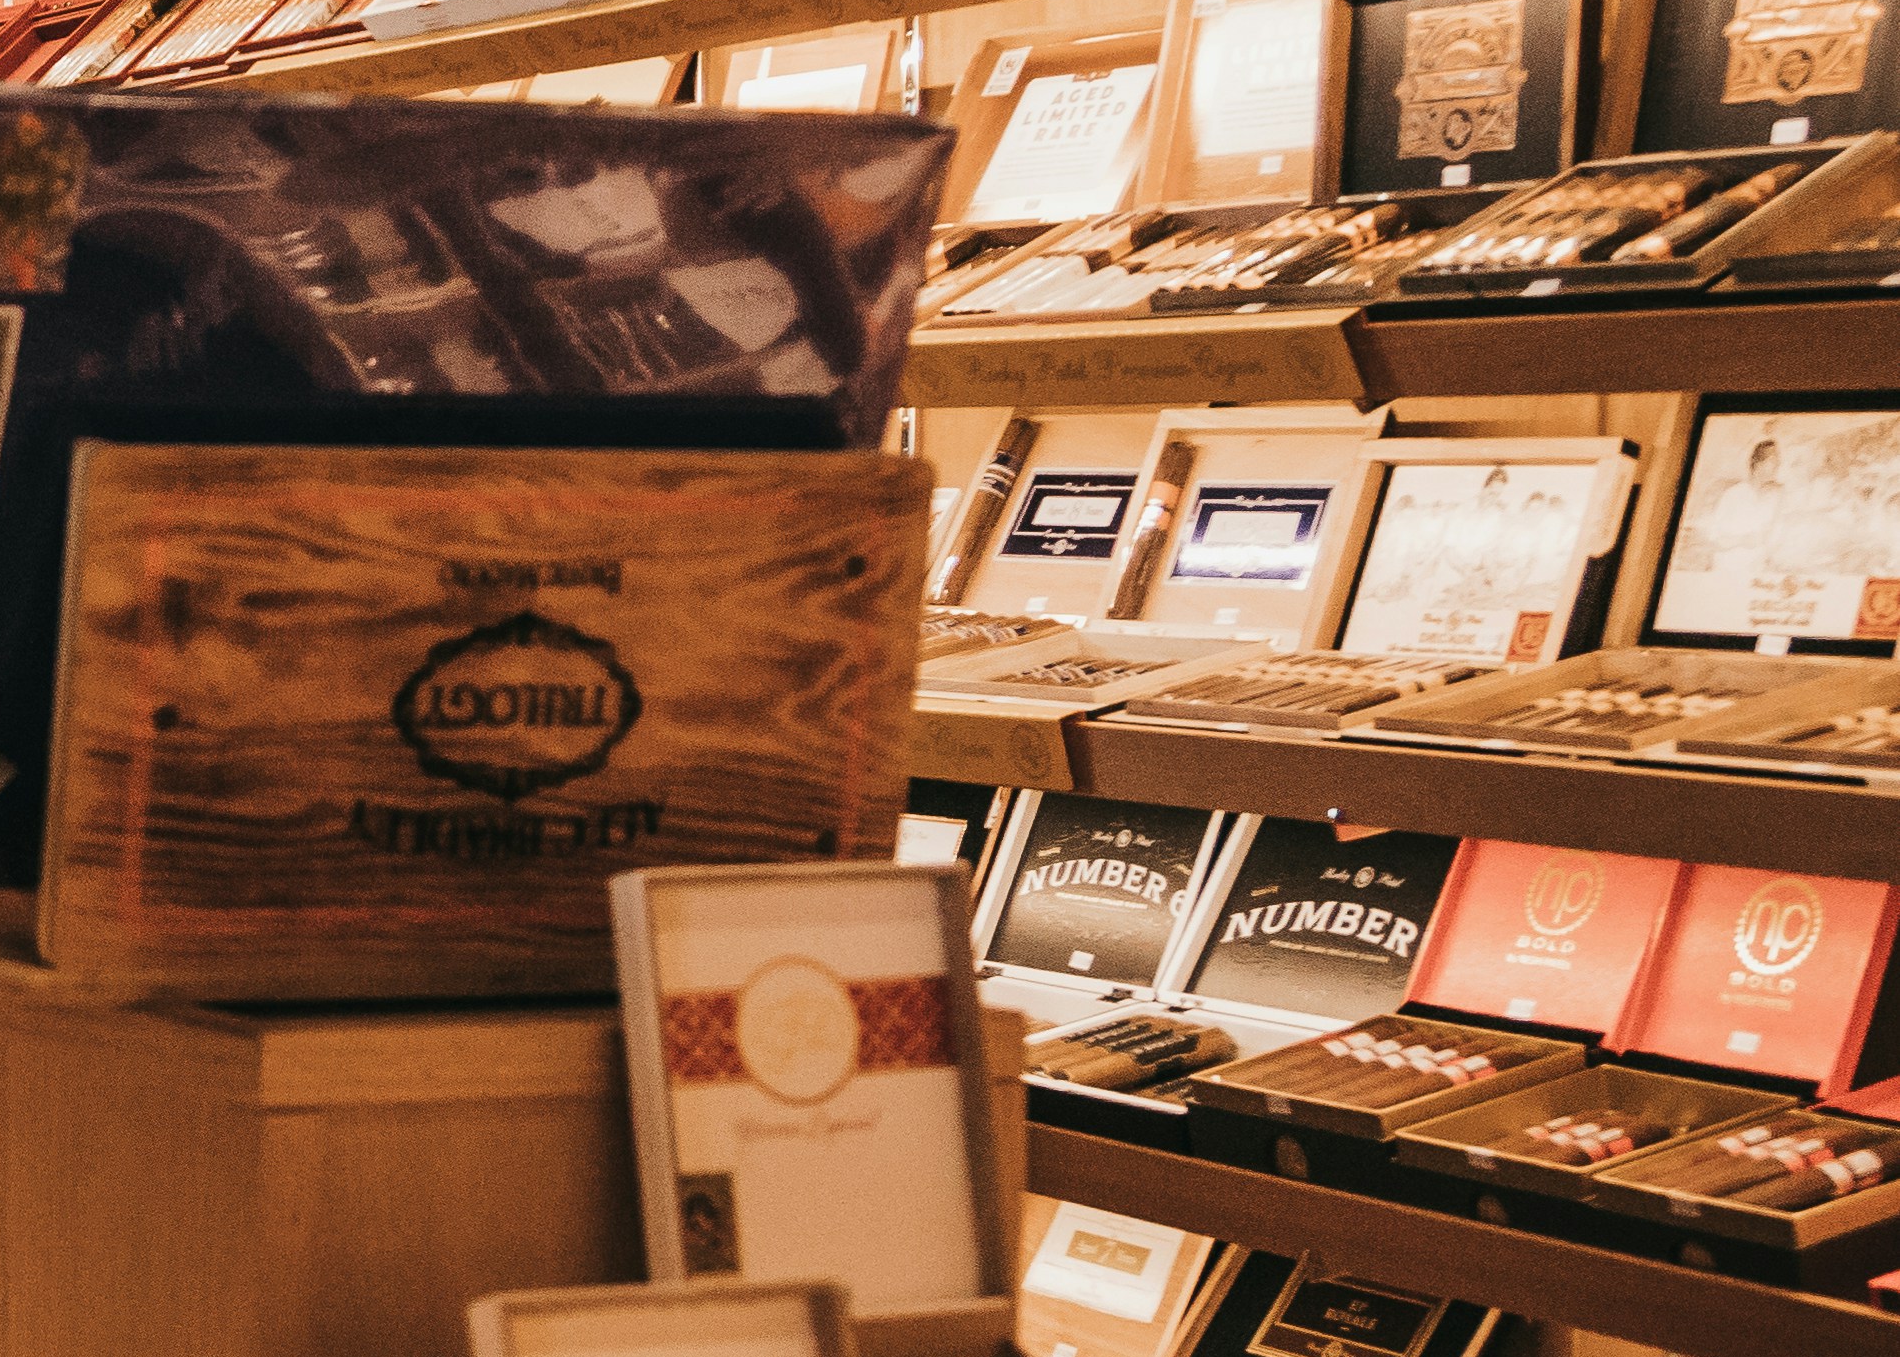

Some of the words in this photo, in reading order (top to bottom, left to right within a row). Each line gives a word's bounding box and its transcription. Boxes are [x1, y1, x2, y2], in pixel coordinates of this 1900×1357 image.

[1051, 85, 1116, 106] AGED
[1022, 101, 1127, 126] LIMITED
[1033, 124, 1098, 143] RARE
[417, 683, 610, 729] TRILOGY
[1019, 858, 1169, 905] NUMBER
[1220, 900, 1421, 959] NUMBER
[1514, 935, 1576, 954] BOLD
[1728, 970, 1797, 994] BOLD
